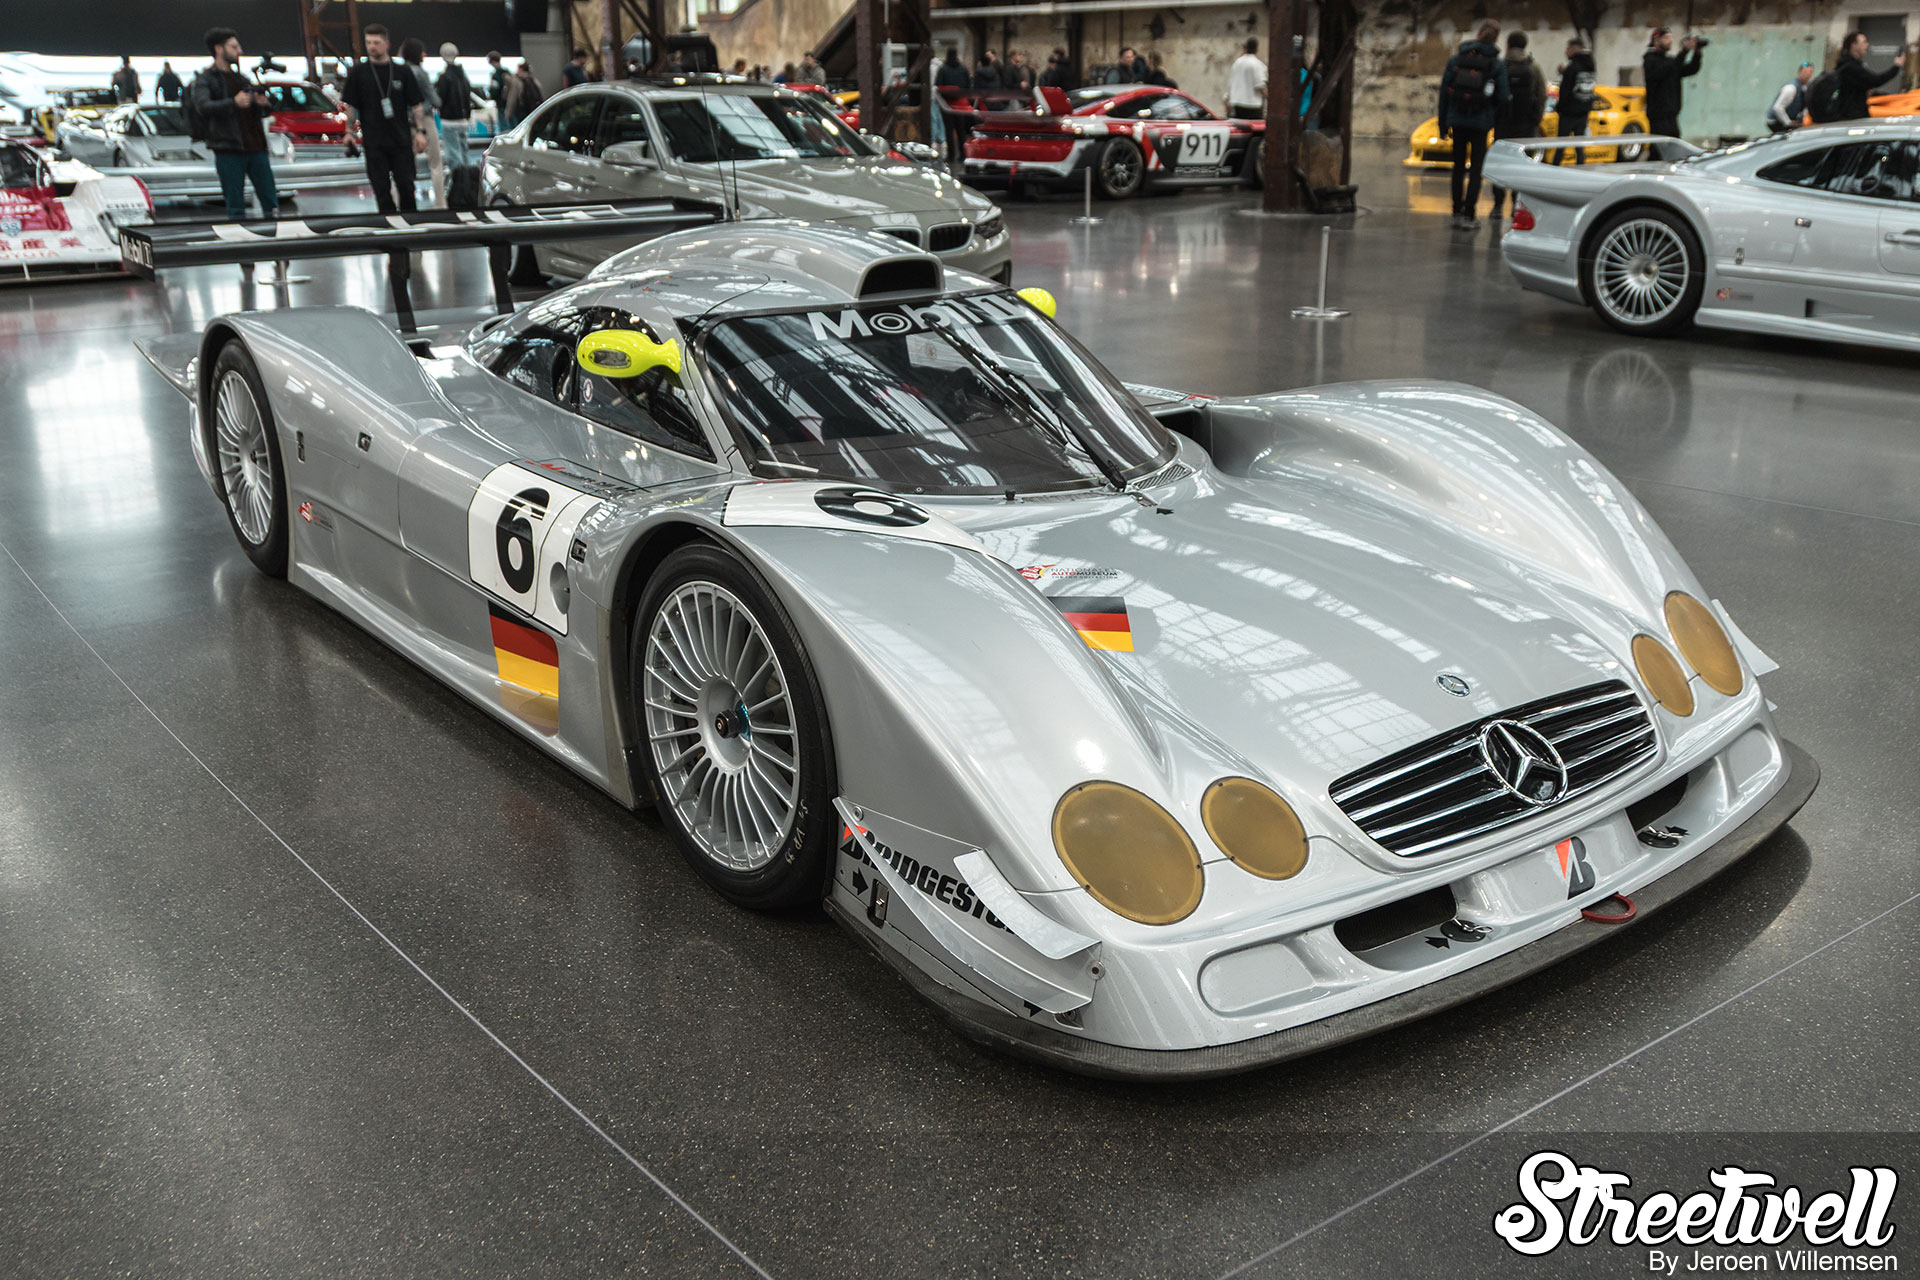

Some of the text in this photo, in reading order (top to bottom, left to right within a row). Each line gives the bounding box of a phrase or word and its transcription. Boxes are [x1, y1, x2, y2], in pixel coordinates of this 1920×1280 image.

[1186, 132, 1221, 156] 911
[807, 294, 1032, 341] Mobil 1
[813, 486, 930, 527] 6
[496, 486, 550, 594] 6
